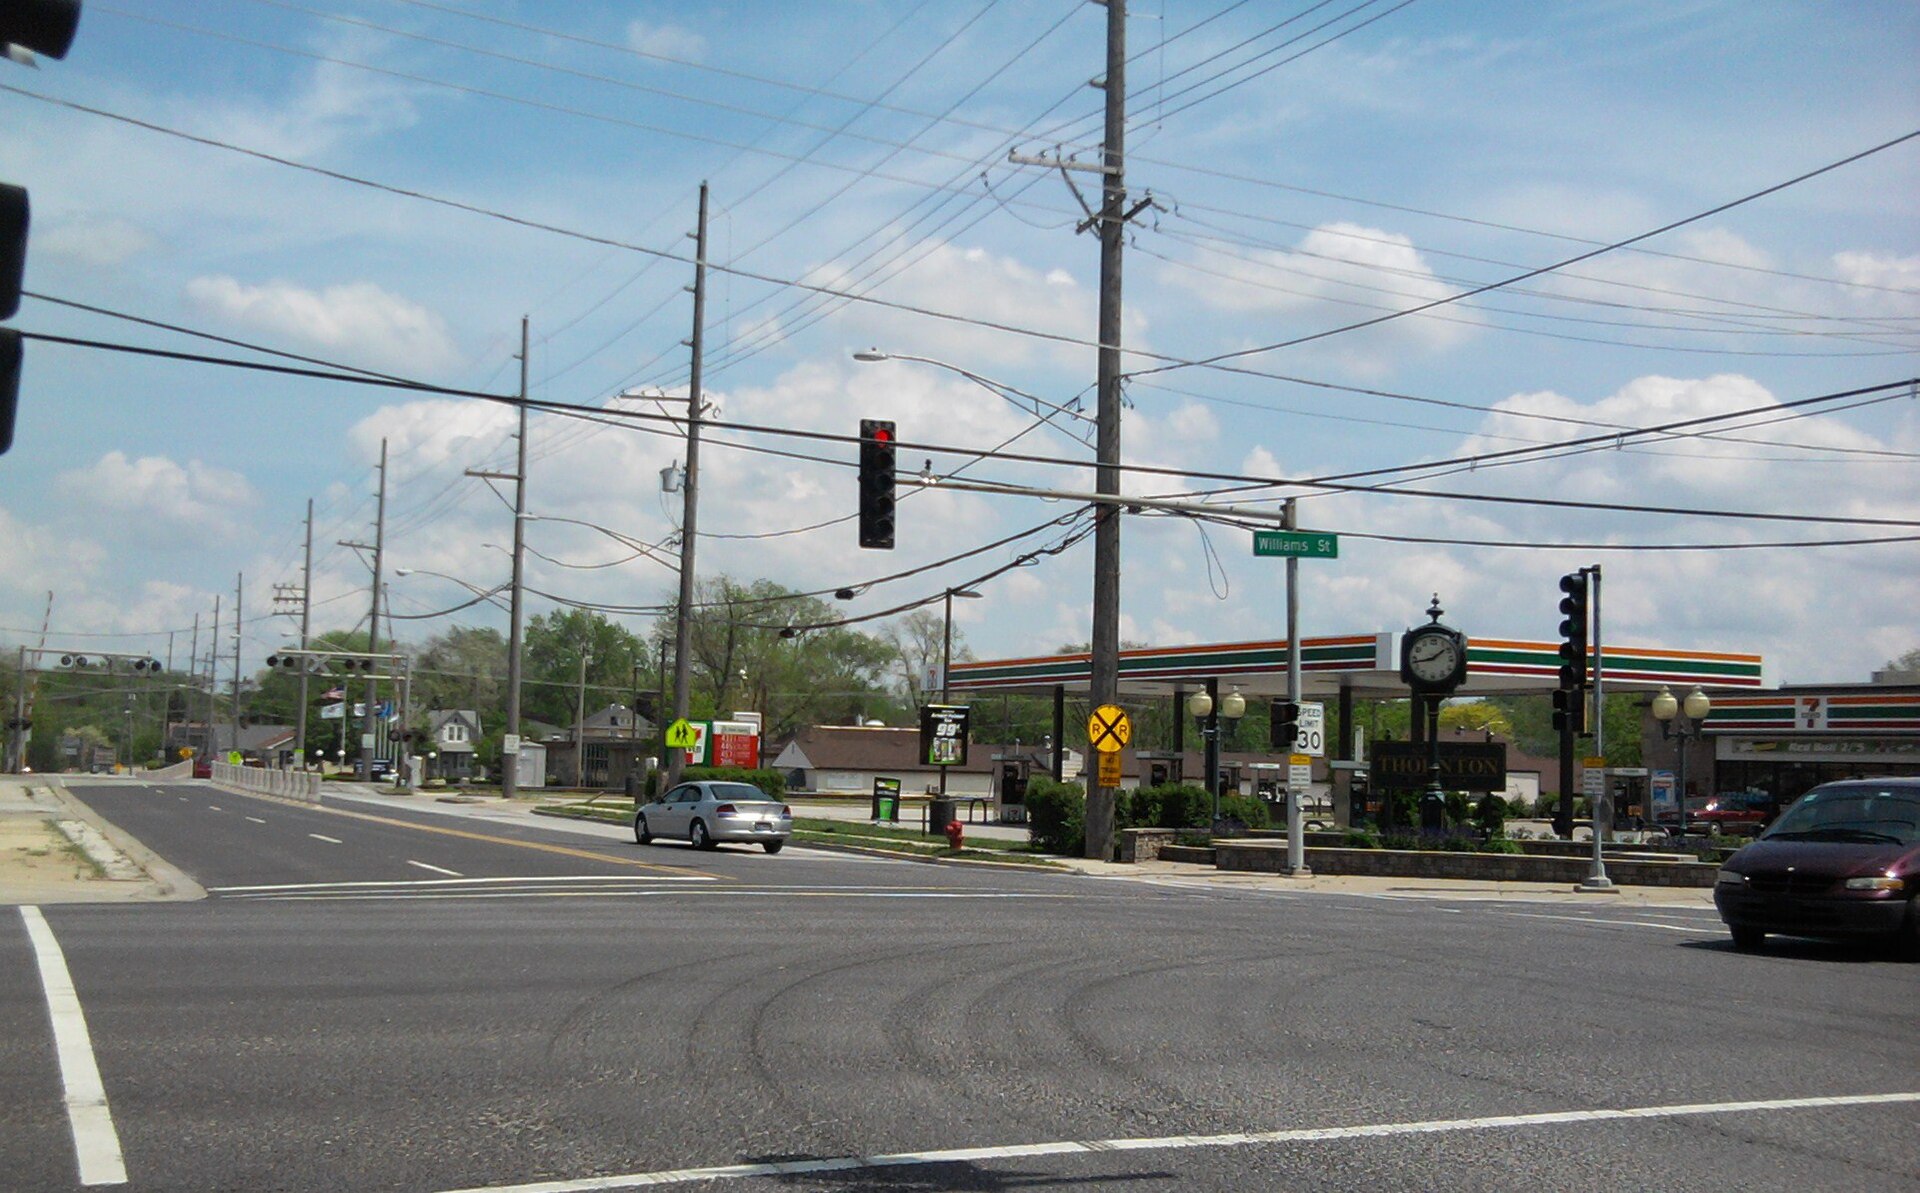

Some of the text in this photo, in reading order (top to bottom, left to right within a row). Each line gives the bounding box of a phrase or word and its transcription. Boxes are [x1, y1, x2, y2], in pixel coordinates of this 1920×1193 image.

[1258, 538, 1331, 553] Williams St
[1300, 719, 1319, 728] LIMIT
[1298, 730, 1321, 750] 30
[1379, 755, 1499, 775] THONTON
